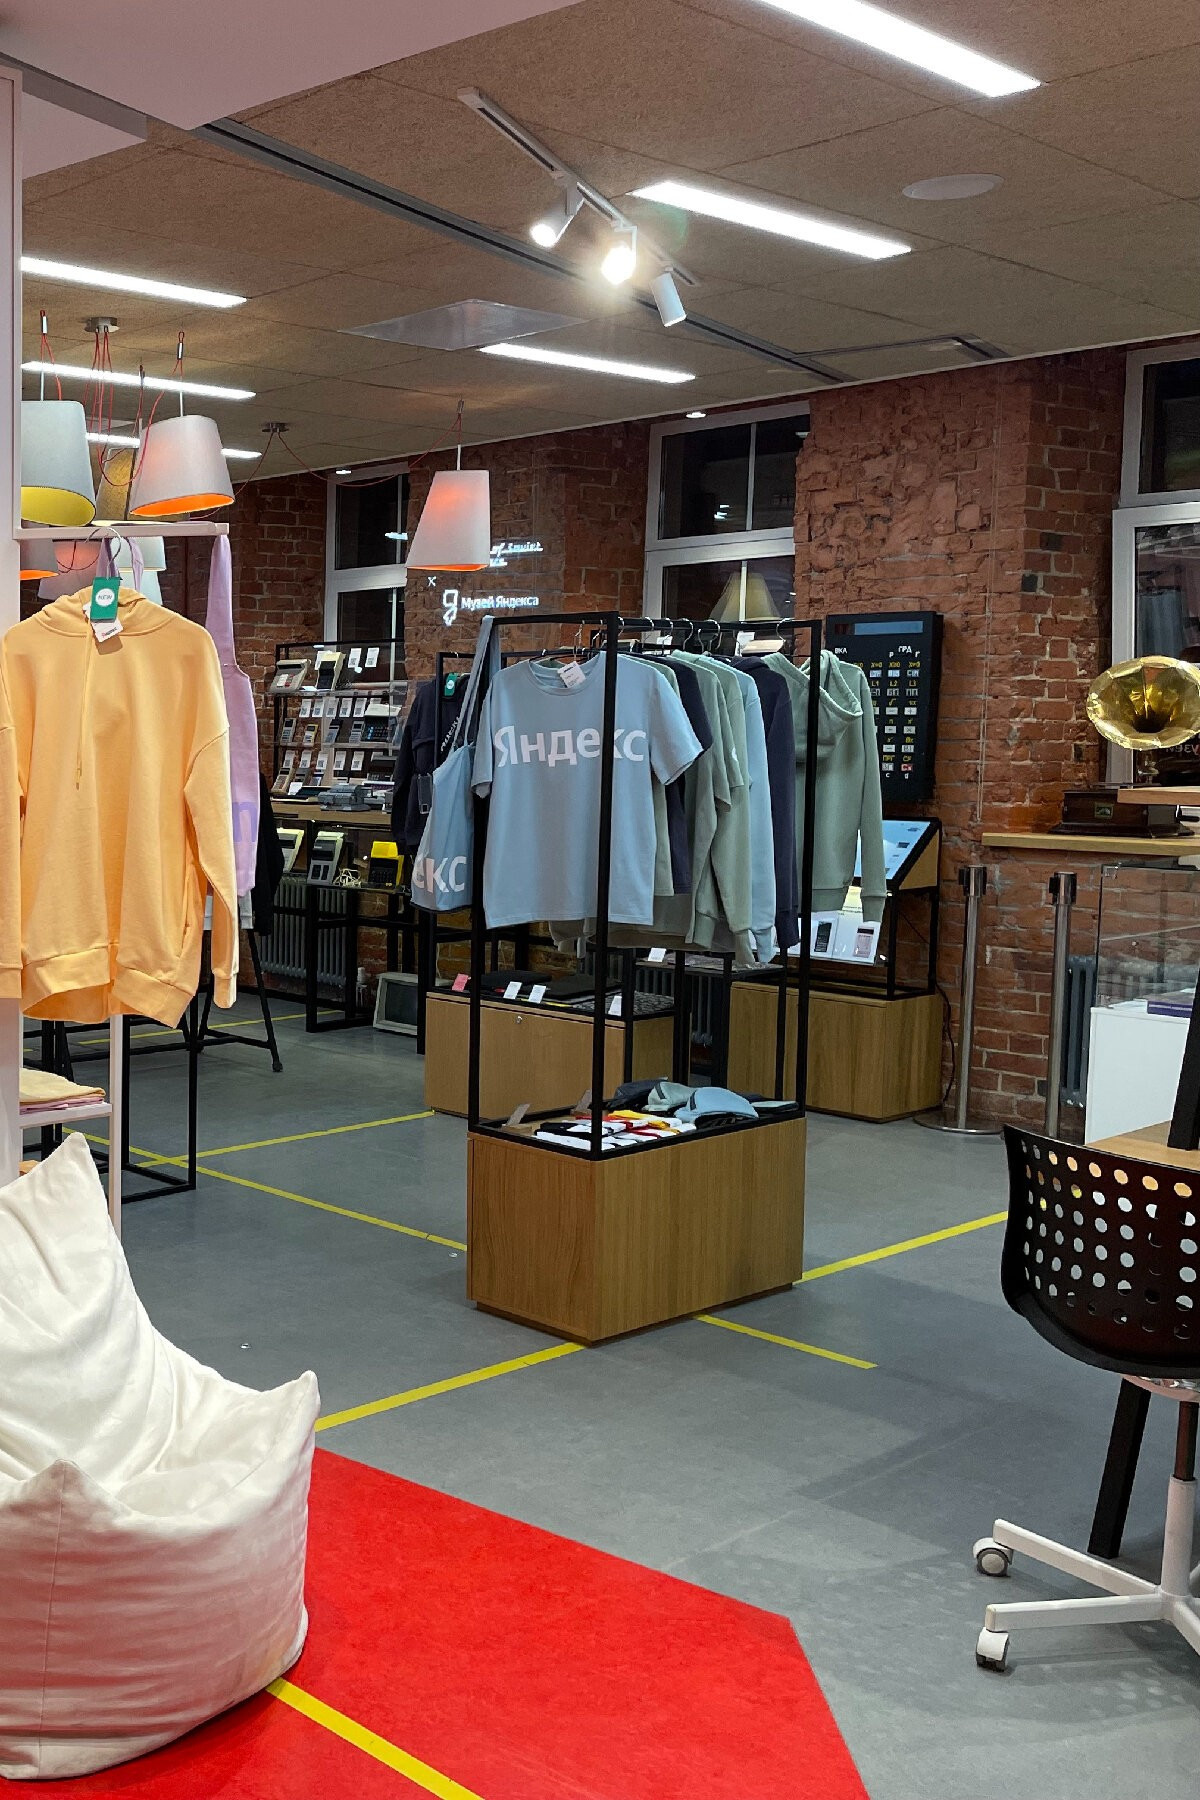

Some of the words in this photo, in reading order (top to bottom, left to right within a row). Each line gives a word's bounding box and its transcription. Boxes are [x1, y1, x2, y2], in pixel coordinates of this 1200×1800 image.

[461, 596, 495, 611] Музей
[496, 595, 540, 608] Яндекса
[494, 726, 647, 768] Яндекс
